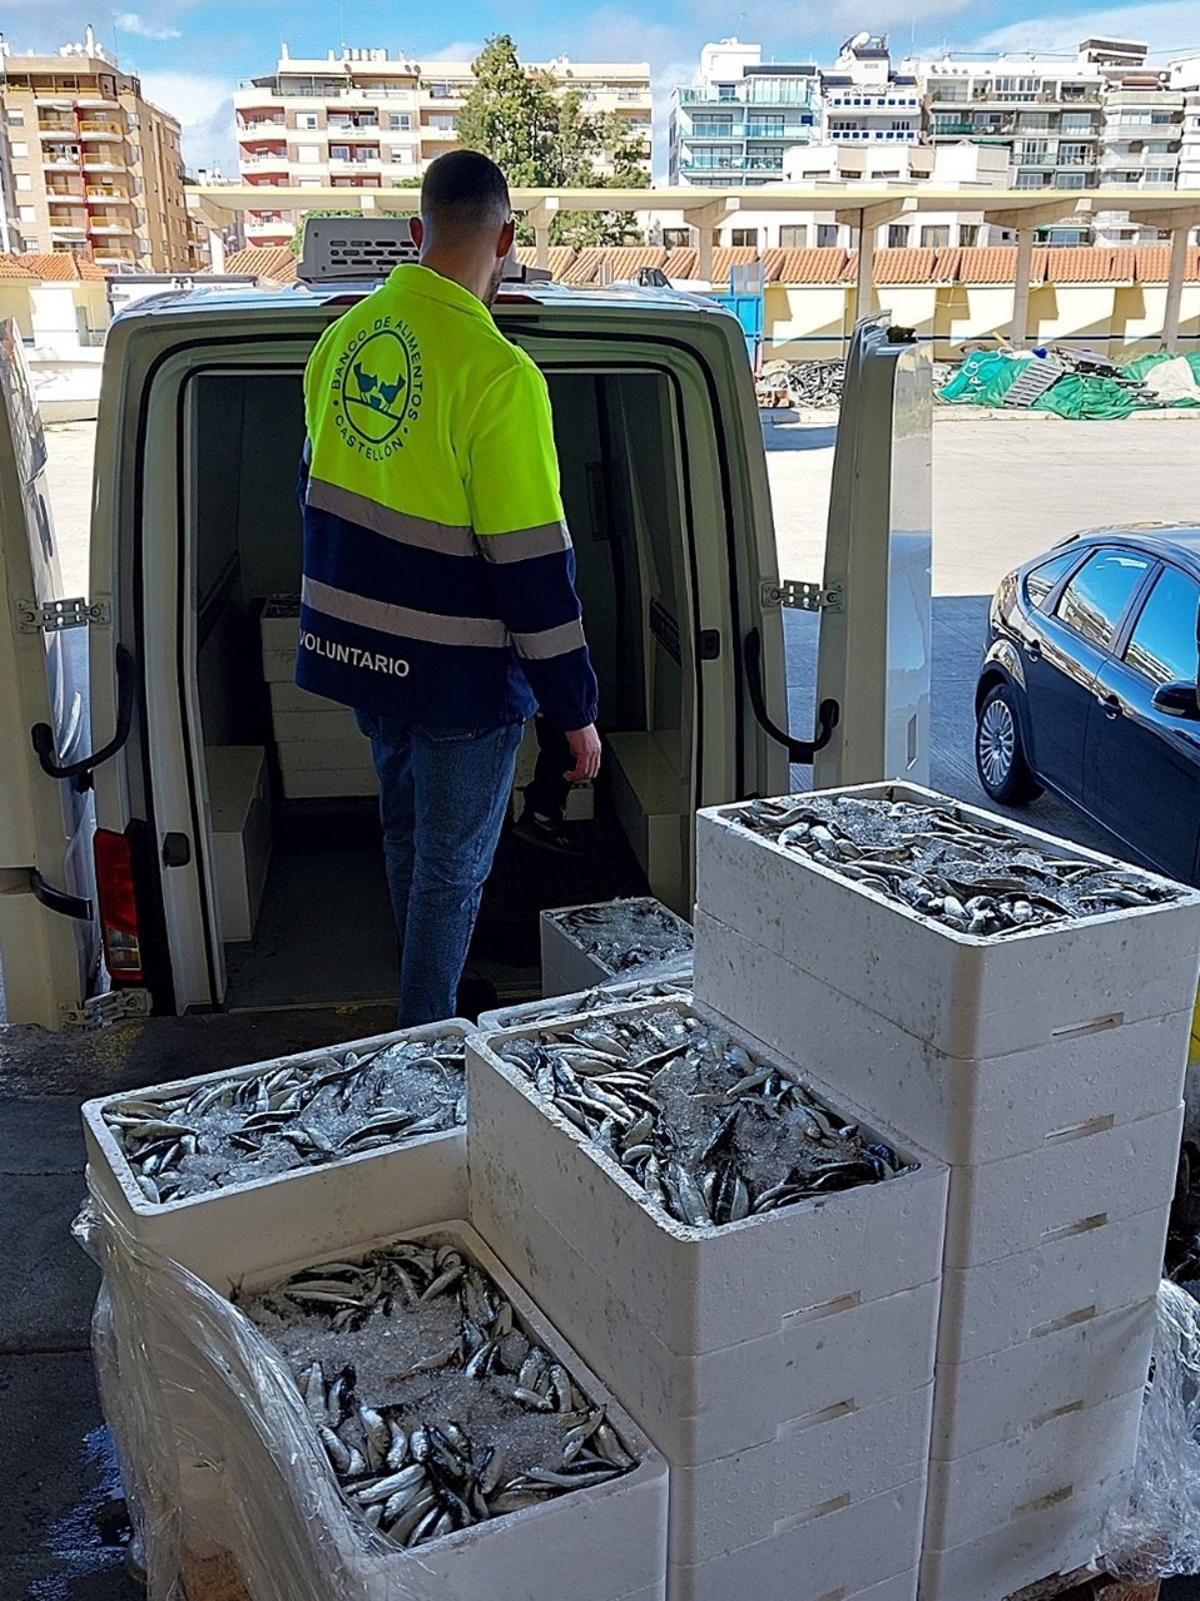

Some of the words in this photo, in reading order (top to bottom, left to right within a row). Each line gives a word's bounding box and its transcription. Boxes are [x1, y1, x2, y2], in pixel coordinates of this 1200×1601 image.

[332, 330, 367, 389] BANCO
[374, 316, 392, 331] DE
[395, 319, 423, 421] ALIMENTOS
